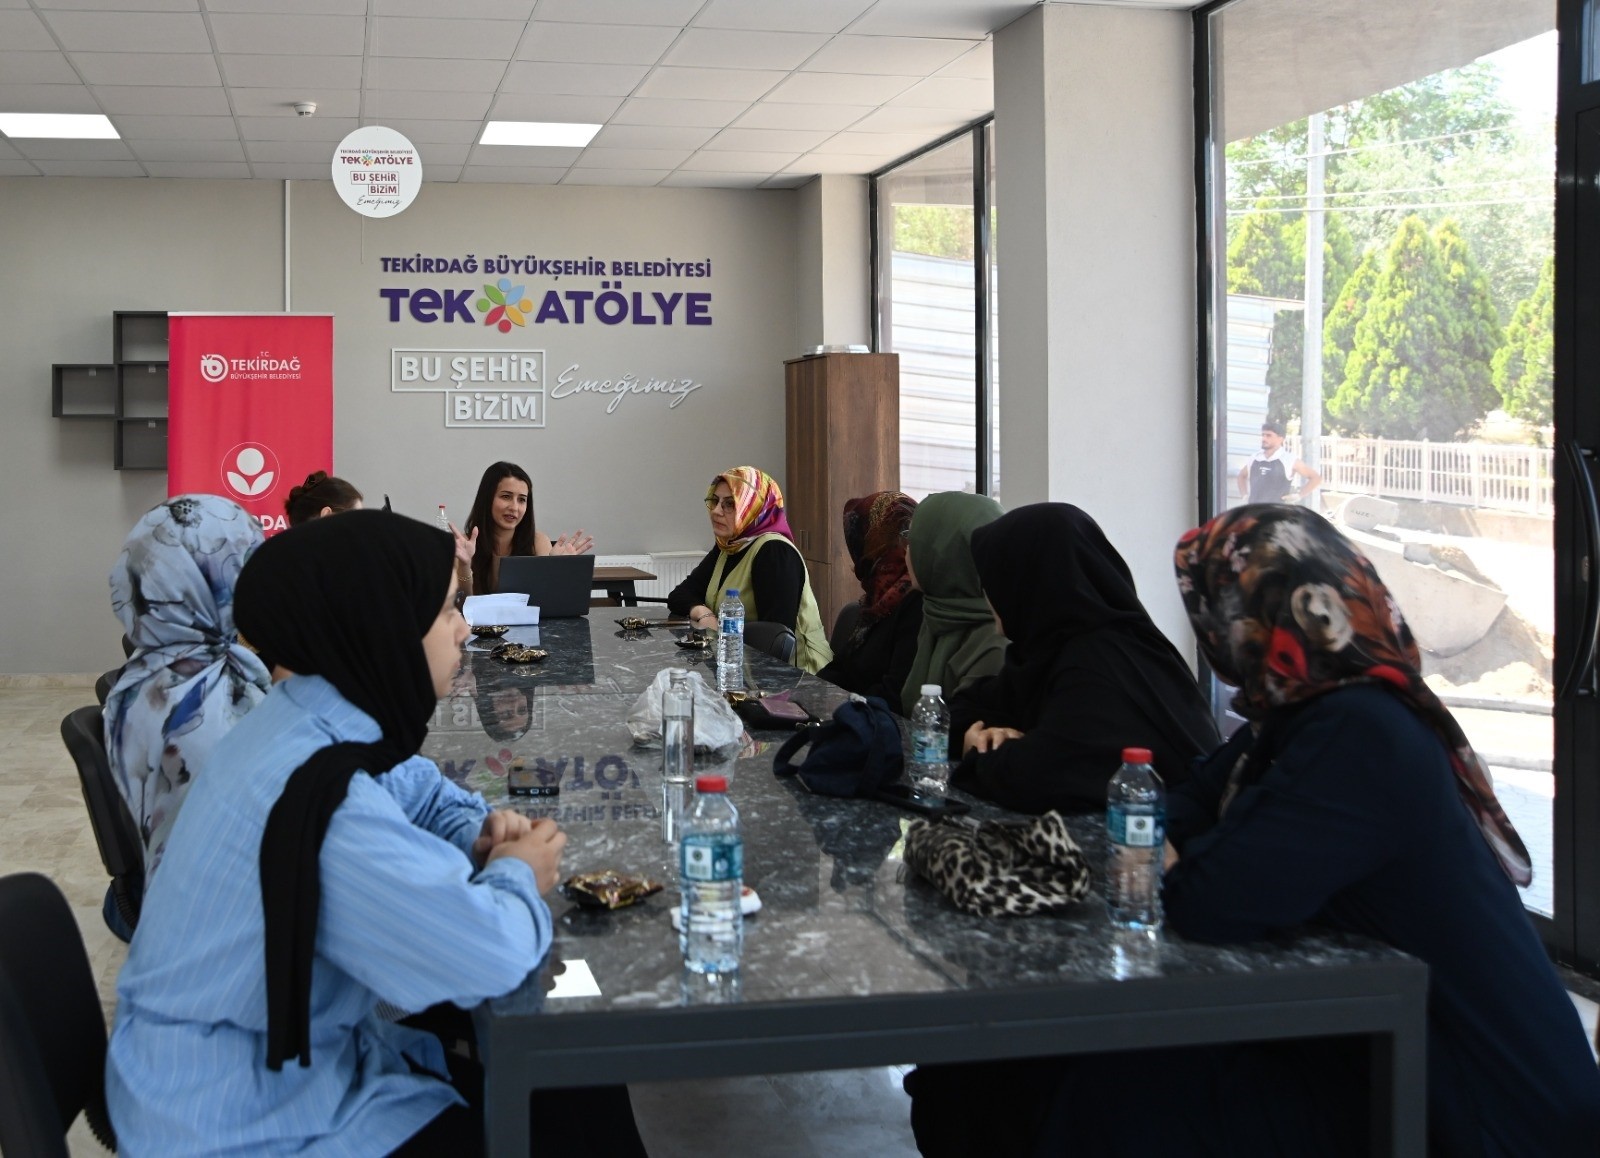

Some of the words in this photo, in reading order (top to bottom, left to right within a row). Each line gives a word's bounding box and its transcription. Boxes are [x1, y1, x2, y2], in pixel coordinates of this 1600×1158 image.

[374, 154, 413, 165] ATÖLYE
[353, 173, 366, 181] BU
[369, 172, 397, 184] ŞEHİR
[370, 184, 397, 194] BİZİM
[380, 253, 478, 274] TEKİRDAĞ
[484, 255, 606, 281] BÜYÜKŞEHİR
[612, 258, 712, 278] BELEDİYESİ
[534, 281, 713, 326] ATÖLYE
[230, 355, 301, 371] TEKİRDAĞ
[400, 357, 442, 382] BU
[450, 354, 538, 389] ŞEHİR
[550, 363, 703, 415] Emeğimiz
[454, 392, 537, 421] BİZİM
